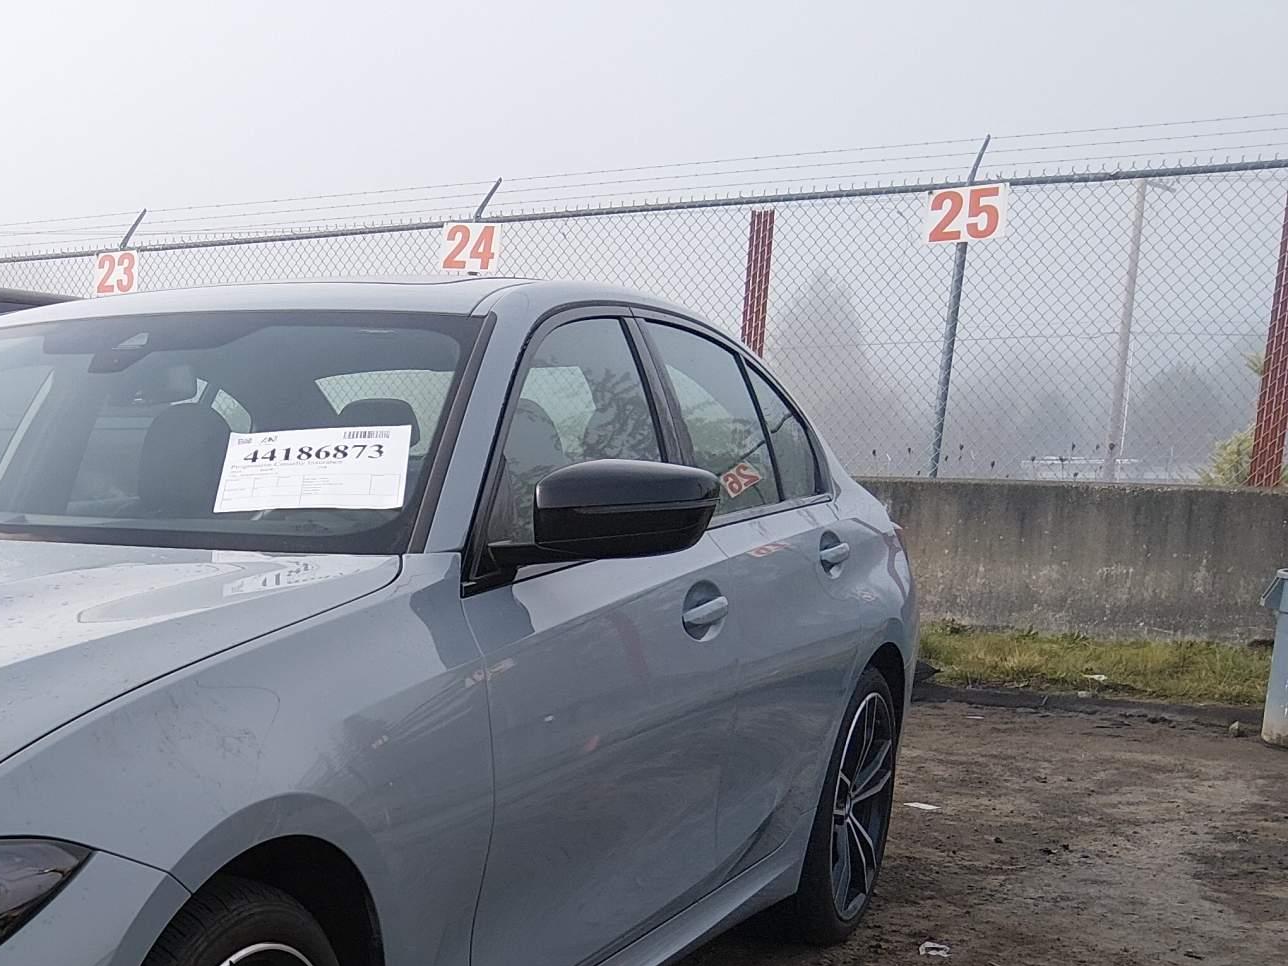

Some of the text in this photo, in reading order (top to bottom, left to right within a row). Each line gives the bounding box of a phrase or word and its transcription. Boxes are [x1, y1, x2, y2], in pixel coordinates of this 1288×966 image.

[928, 187, 1000, 242] 25
[443, 225, 495, 269] 24
[97, 253, 135, 293] 23
[243, 444, 384, 462] 44186873
